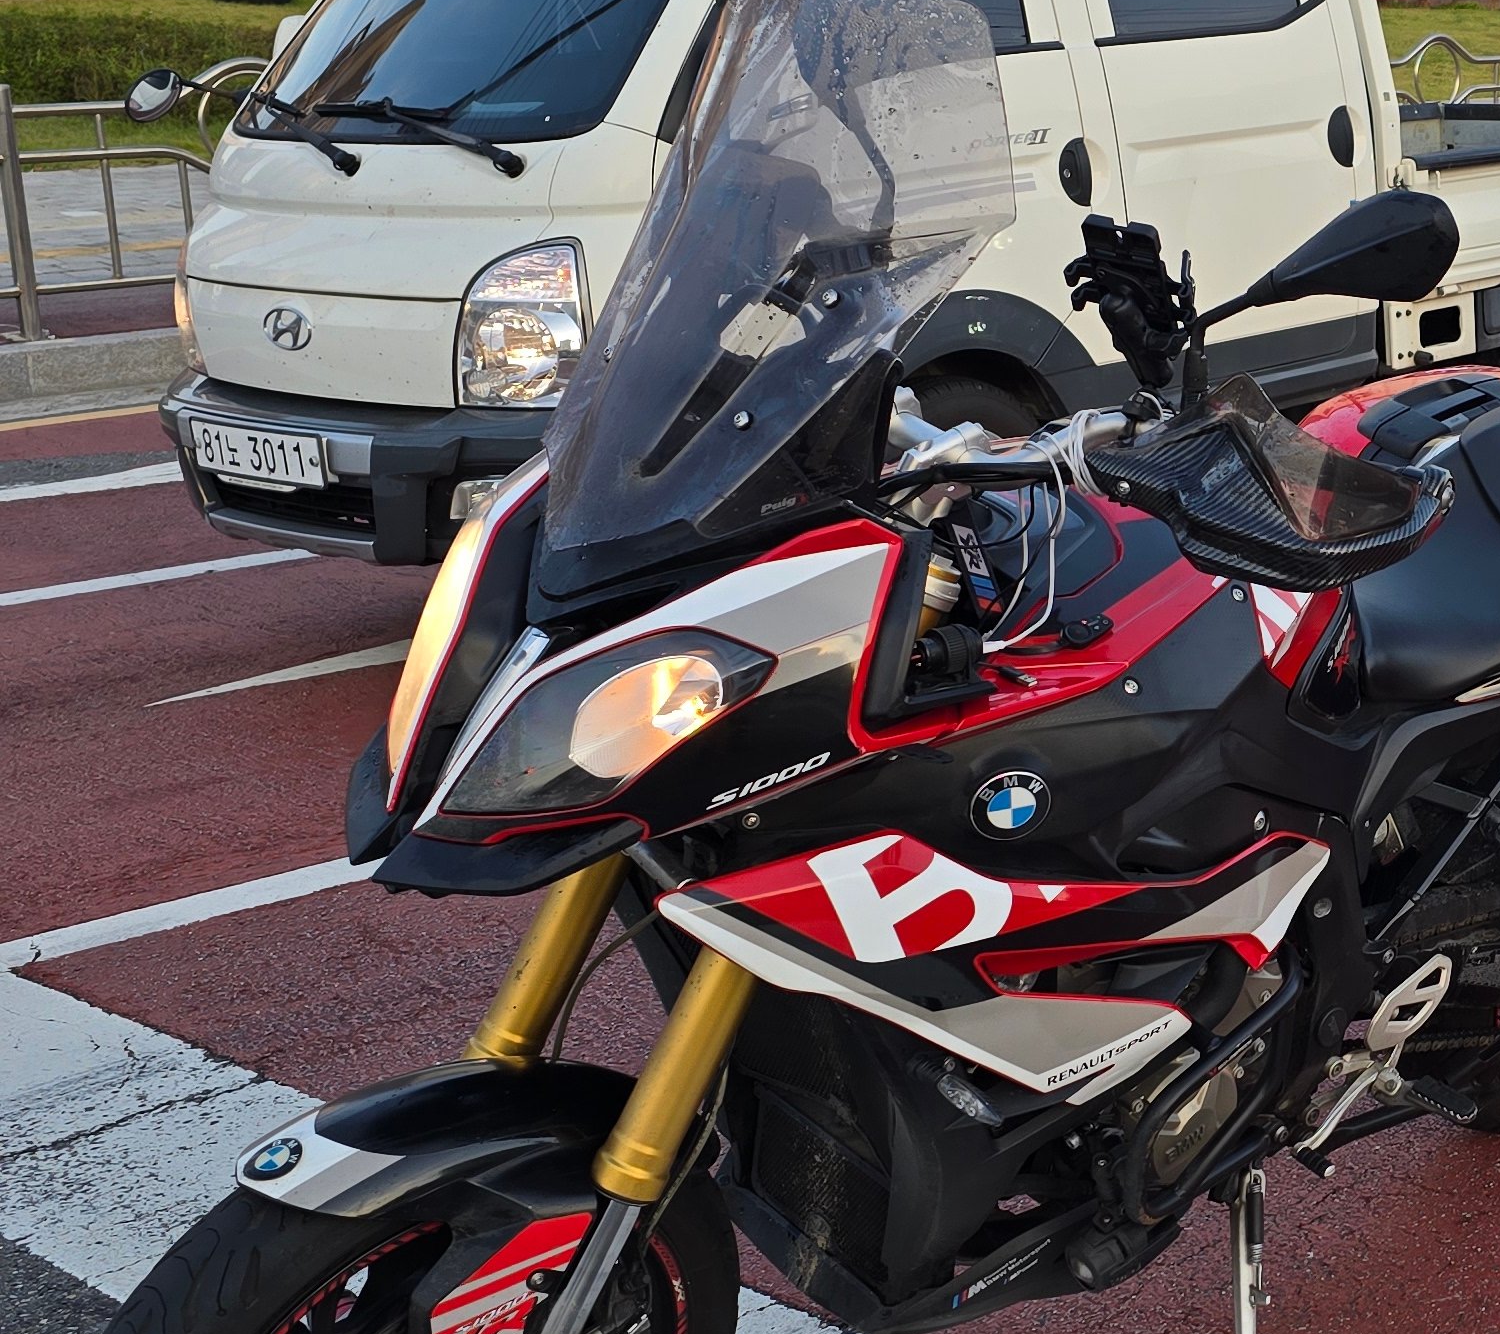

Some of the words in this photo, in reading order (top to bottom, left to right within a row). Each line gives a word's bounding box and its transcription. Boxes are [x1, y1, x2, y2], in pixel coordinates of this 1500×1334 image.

[202, 427, 241, 467] 81노
[247, 435, 305, 478] 3011
[760, 496, 797, 515] Puig
[706, 752, 831, 811] S1000
[979, 774, 1044, 804] BMW
[271, 1139, 300, 1164] BMW
